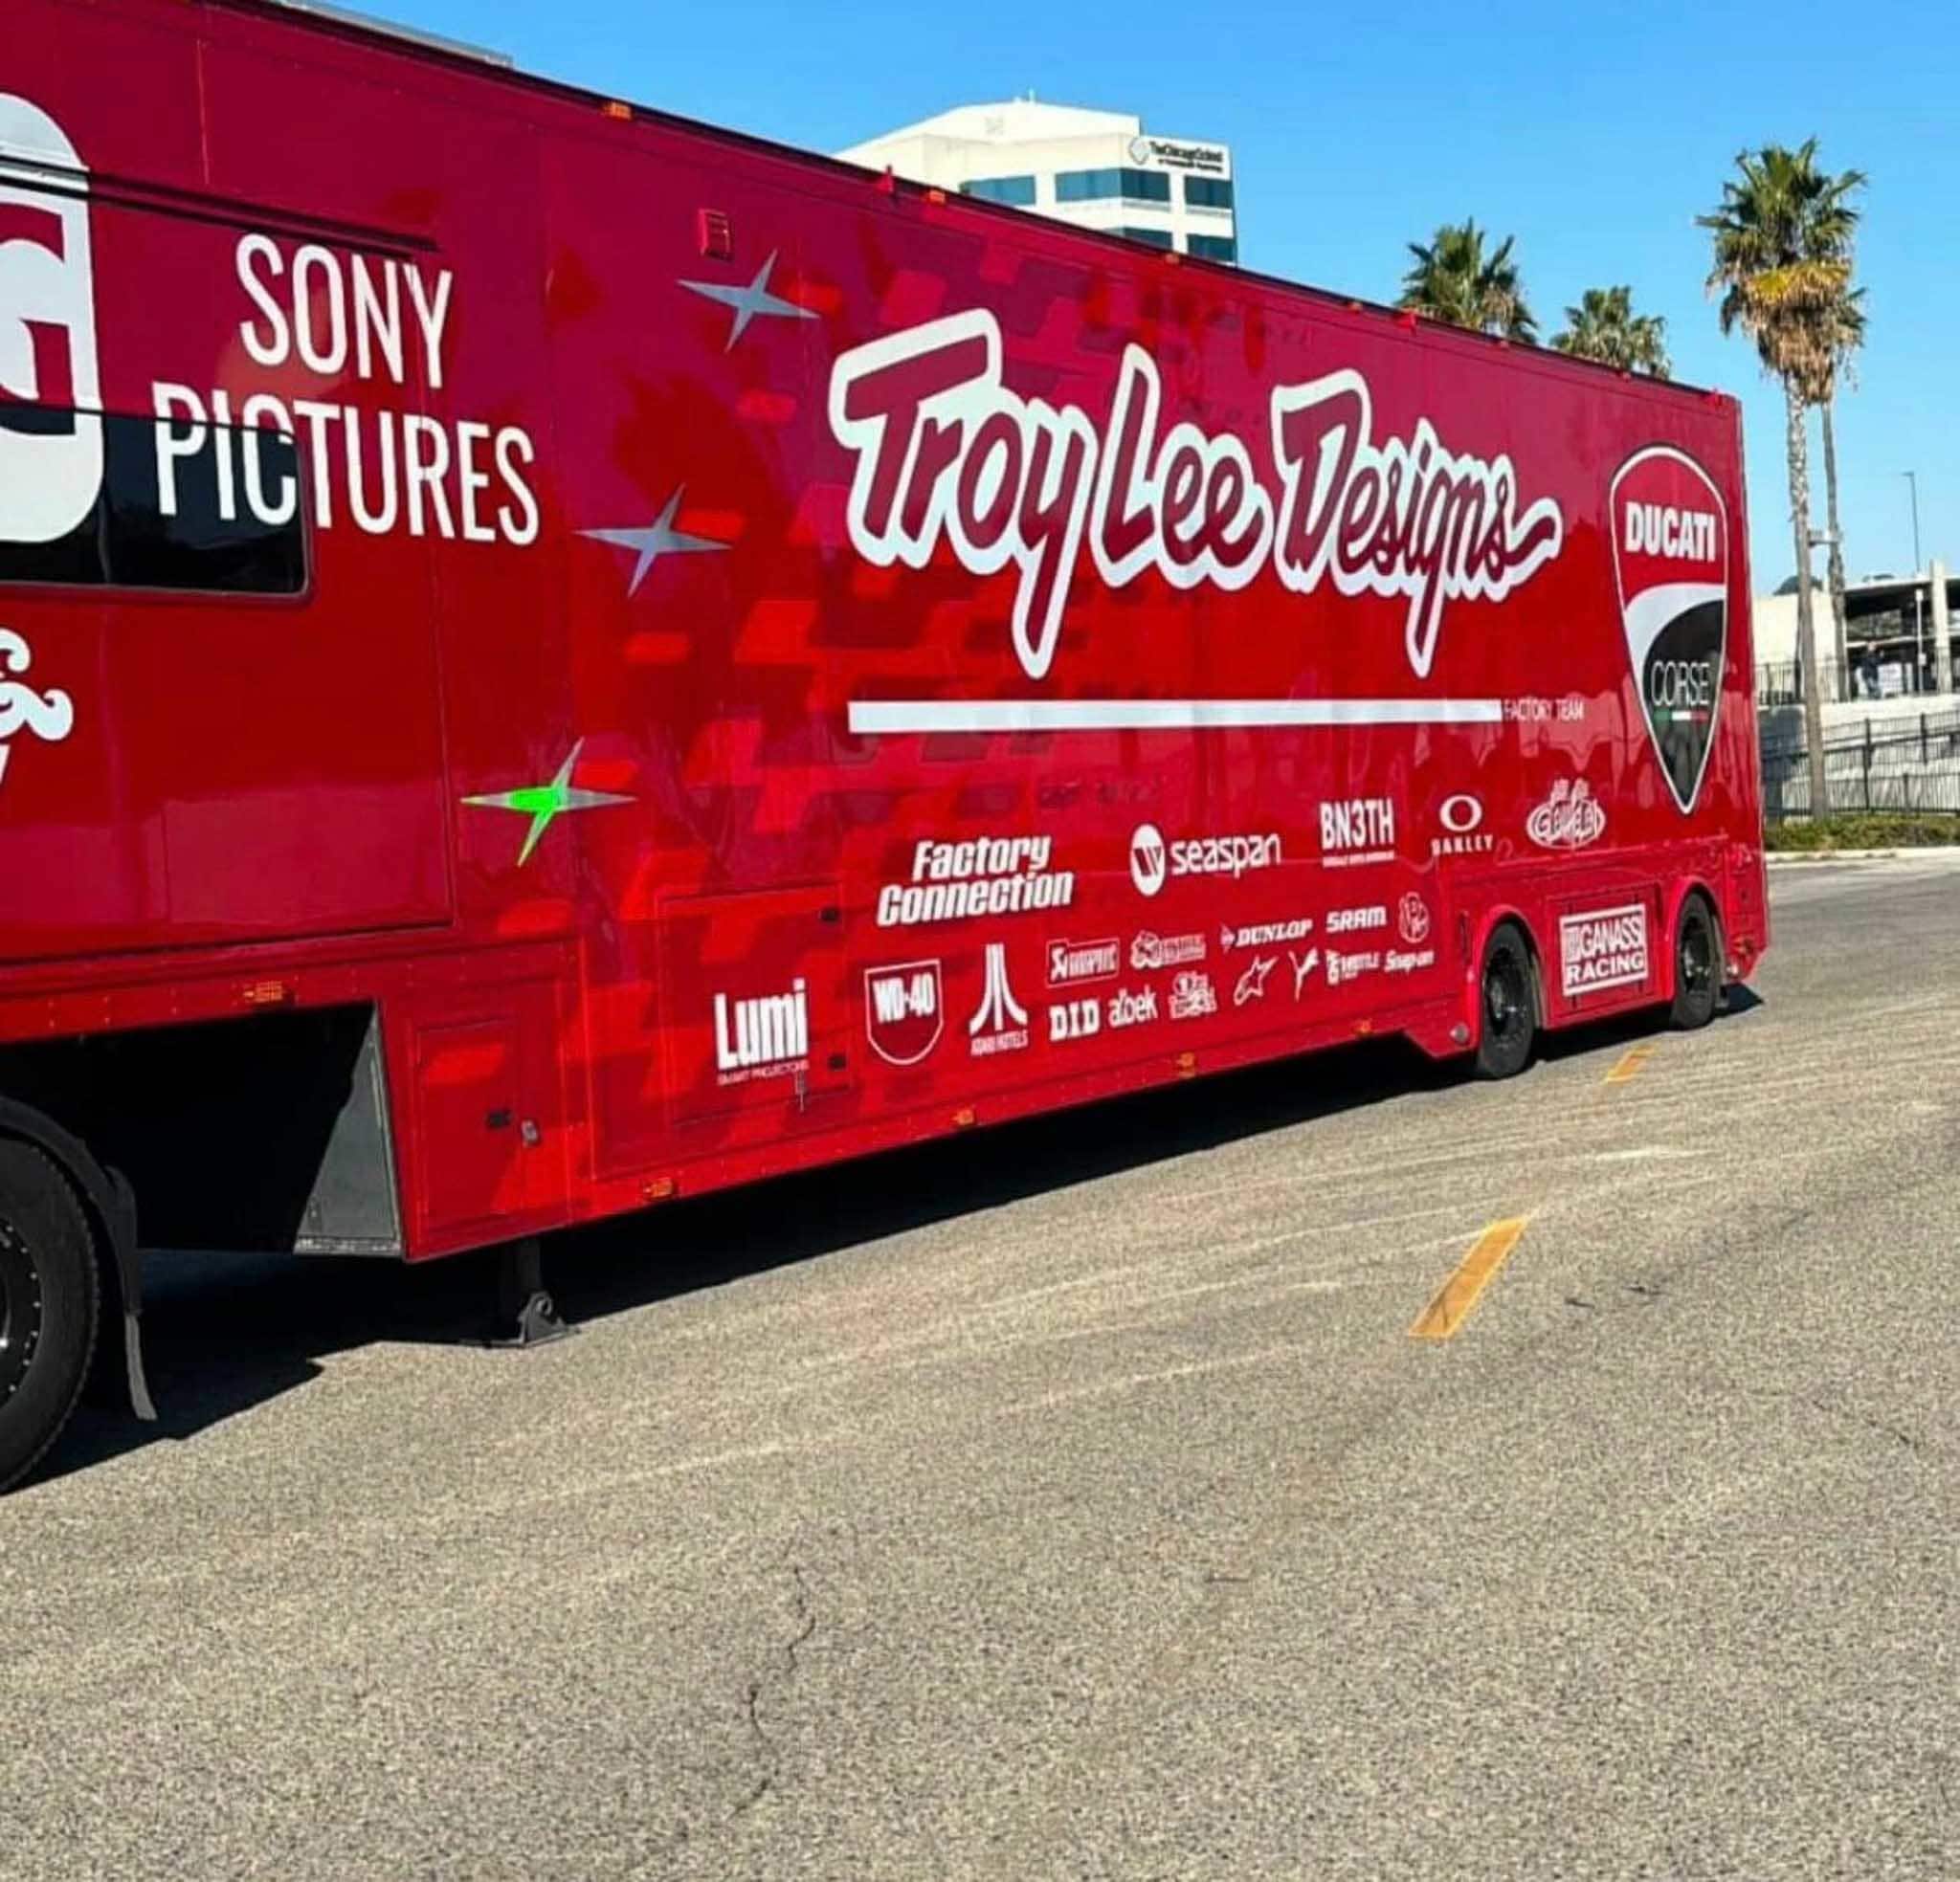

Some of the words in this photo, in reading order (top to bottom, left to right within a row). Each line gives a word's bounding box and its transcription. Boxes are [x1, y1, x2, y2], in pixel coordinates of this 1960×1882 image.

[234, 234, 452, 389] SONY
[152, 380, 540, 545] PICTURES
[829, 307, 1098, 678] Troy
[1097, 343, 1275, 589] Lee
[1271, 368, 1564, 678] Designs
[1624, 500, 1716, 562] DUCATI
[1555, 698, 1586, 720] TEAM
[1650, 661, 1710, 707] CORSE
[1320, 797, 1394, 851] BN3TH
[911, 835, 1052, 881] Factory
[1169, 832, 1281, 879] seaspan
[877, 872, 1075, 927] Connection
[1326, 906, 1387, 933] SRAM
[1236, 918, 1314, 947] DUNLOP
[1566, 951, 1644, 985] RACING
[872, 972, 936, 1024] WD-40
[714, 978, 808, 1071] Lumi
